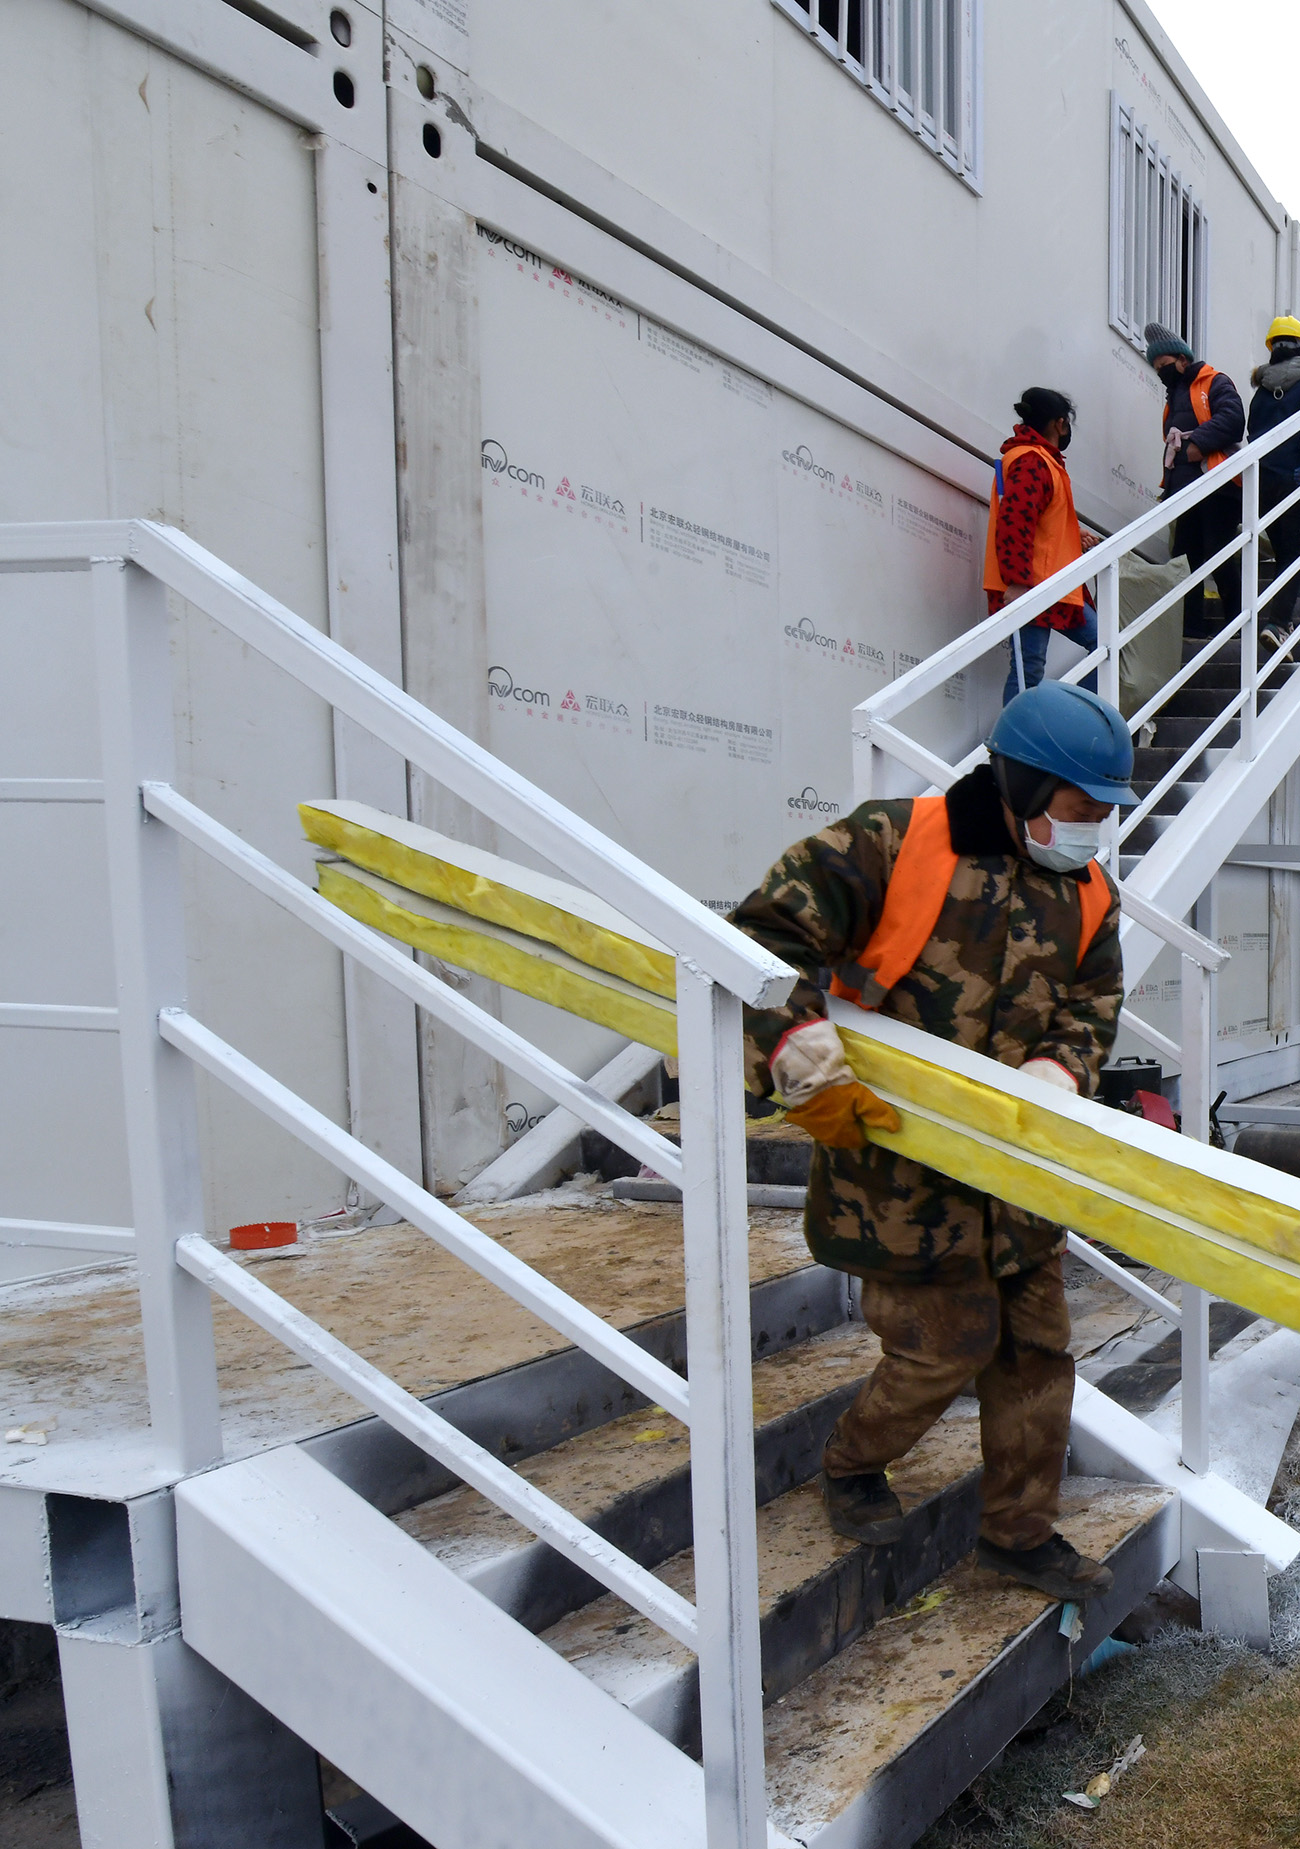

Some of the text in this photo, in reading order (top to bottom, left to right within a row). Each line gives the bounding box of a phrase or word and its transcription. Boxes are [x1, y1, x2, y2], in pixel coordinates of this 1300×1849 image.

[585, 694, 630, 718] 宏联众
[654, 704, 773, 739] 北京宏联众轻钢结构房屋有限公司
